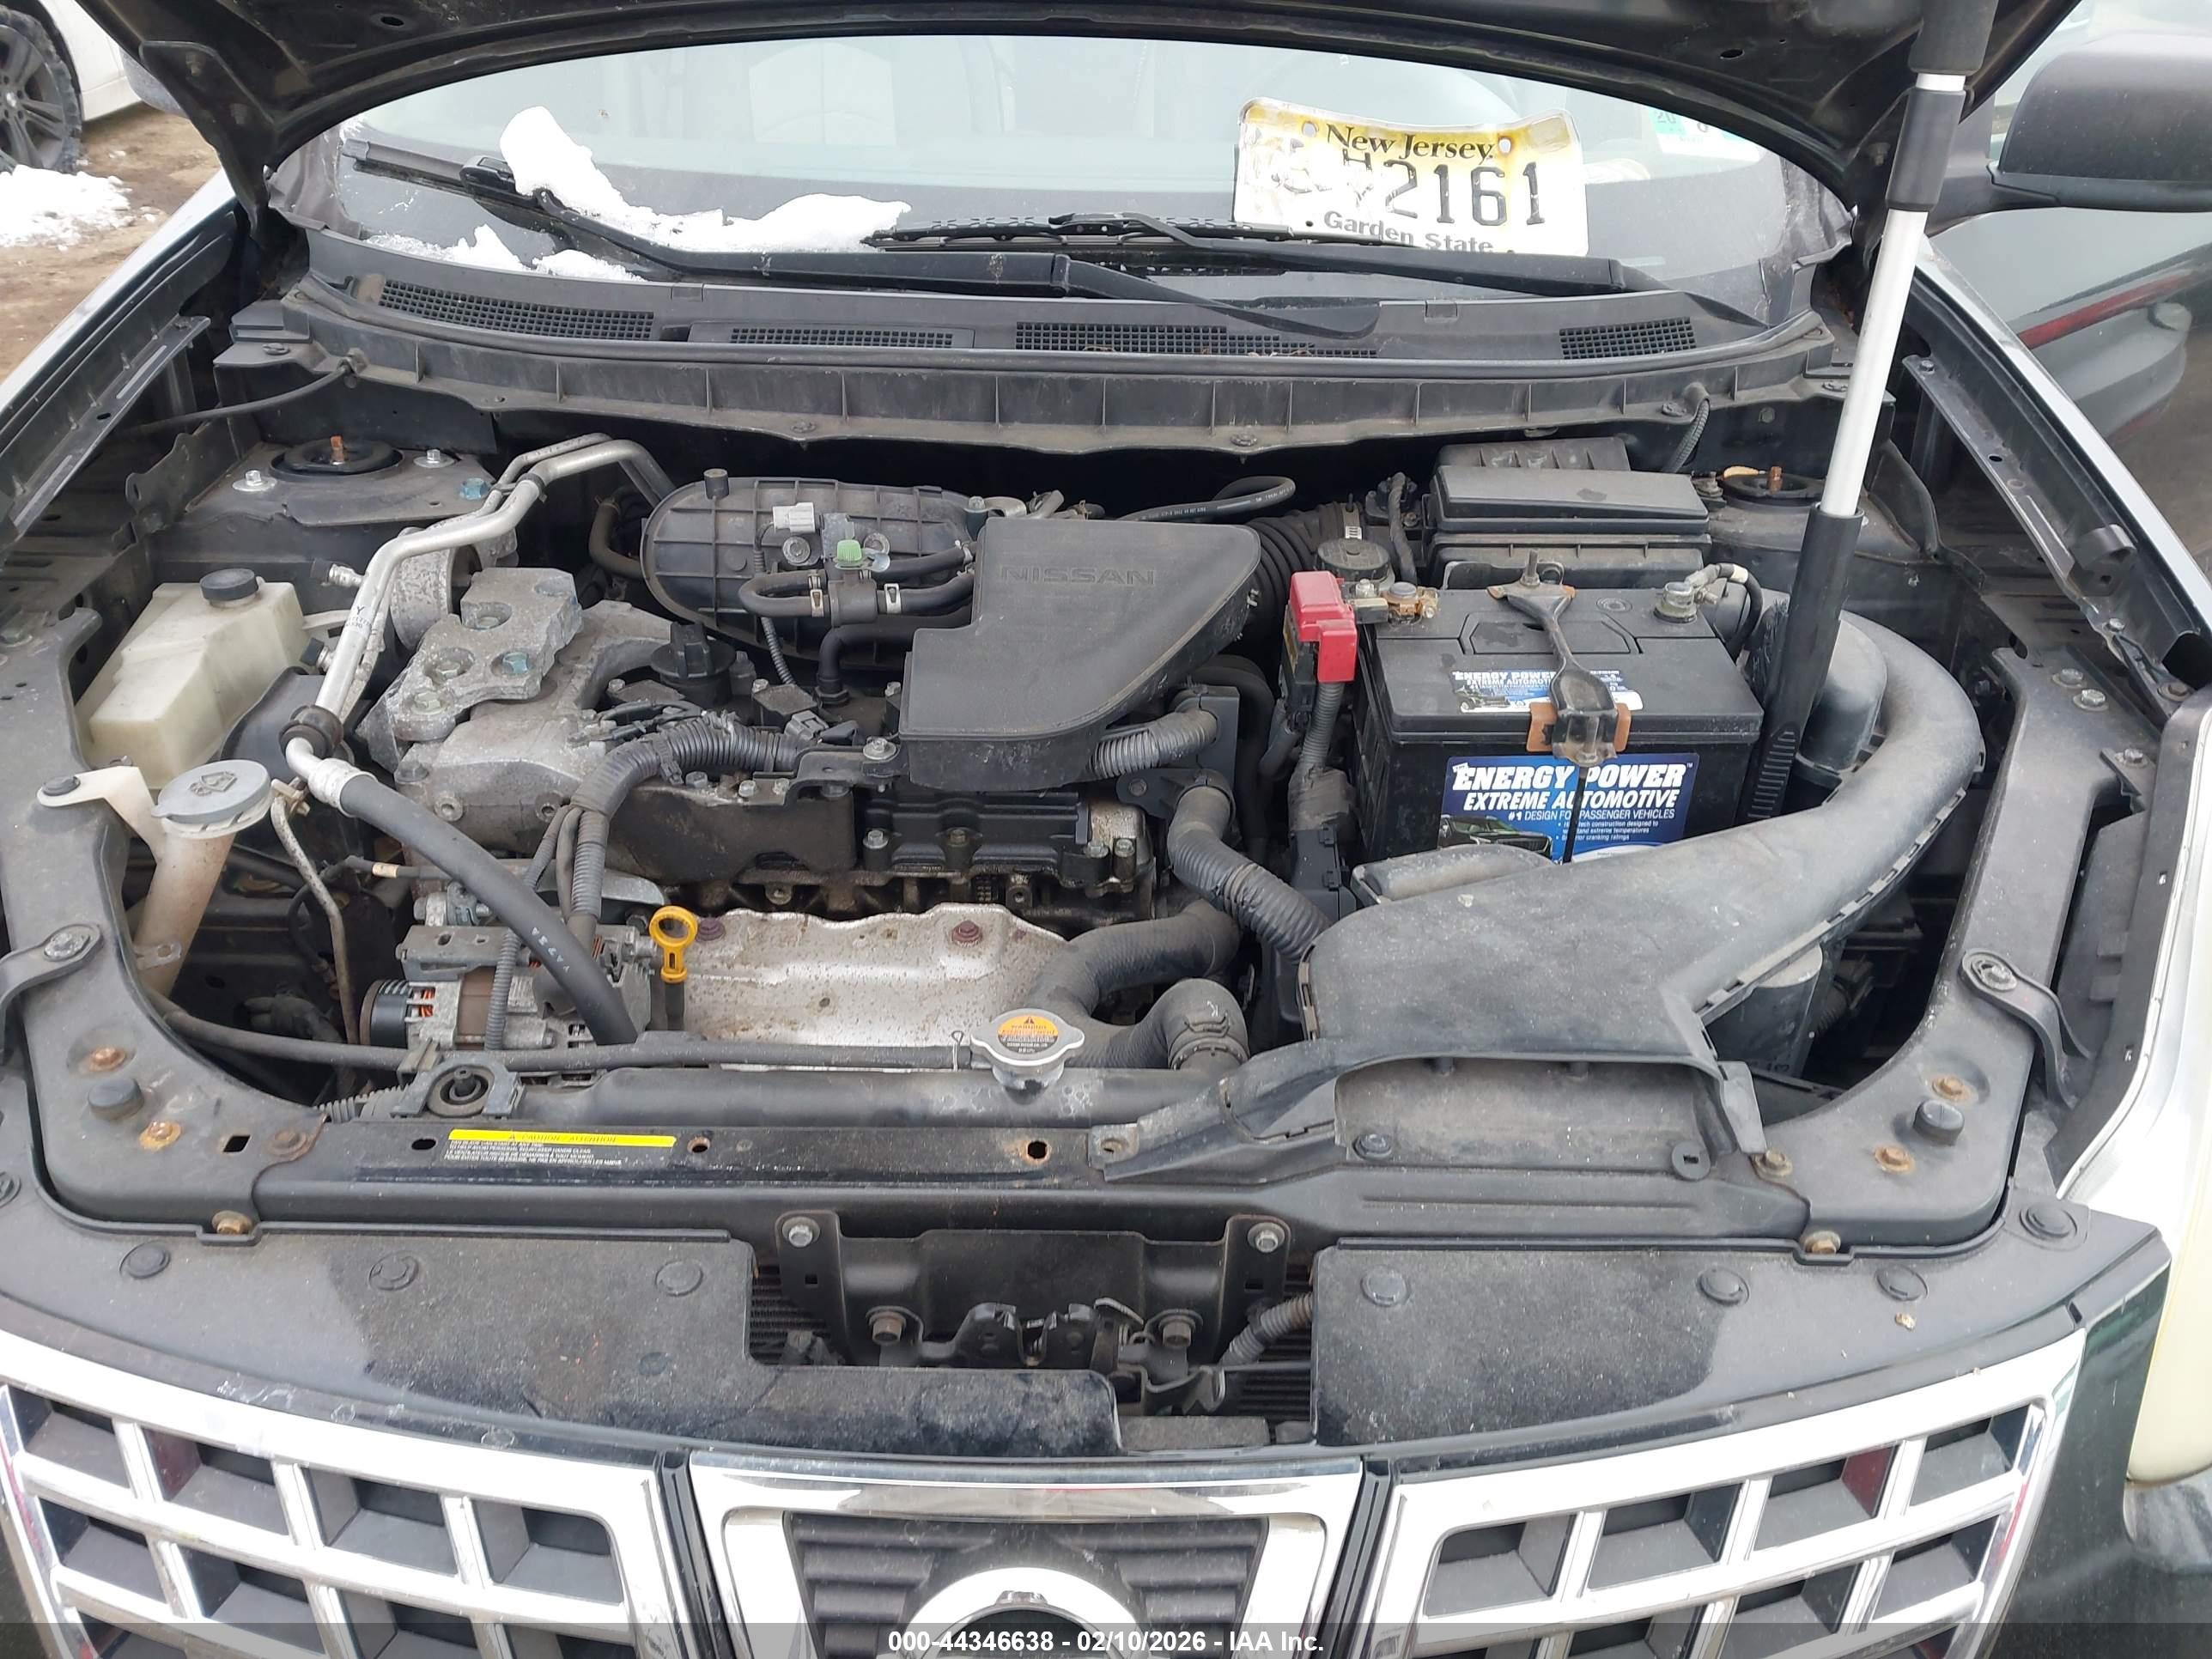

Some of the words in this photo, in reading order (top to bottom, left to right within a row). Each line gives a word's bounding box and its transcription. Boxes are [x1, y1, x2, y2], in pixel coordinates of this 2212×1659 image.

[1327, 124, 1395, 154] New
[1399, 134, 1493, 164] Jersey
[1383, 160, 1546, 226] 2161
[1324, 210, 1414, 246] Garden
[1425, 231, 1492, 252] State
[1002, 565, 1157, 585] NISSAN
[1453, 764, 1575, 791] ENERGY
[1585, 763, 1686, 787] POWER
[1463, 792, 1550, 811] EXTREME
[1508, 811, 1522, 821] #1
[1524, 811, 1557, 821] DESIGN
[1559, 811, 1572, 820] FO
[1579, 810, 1631, 820] PASSENGER
[1632, 809, 1675, 819] VEHICLES
